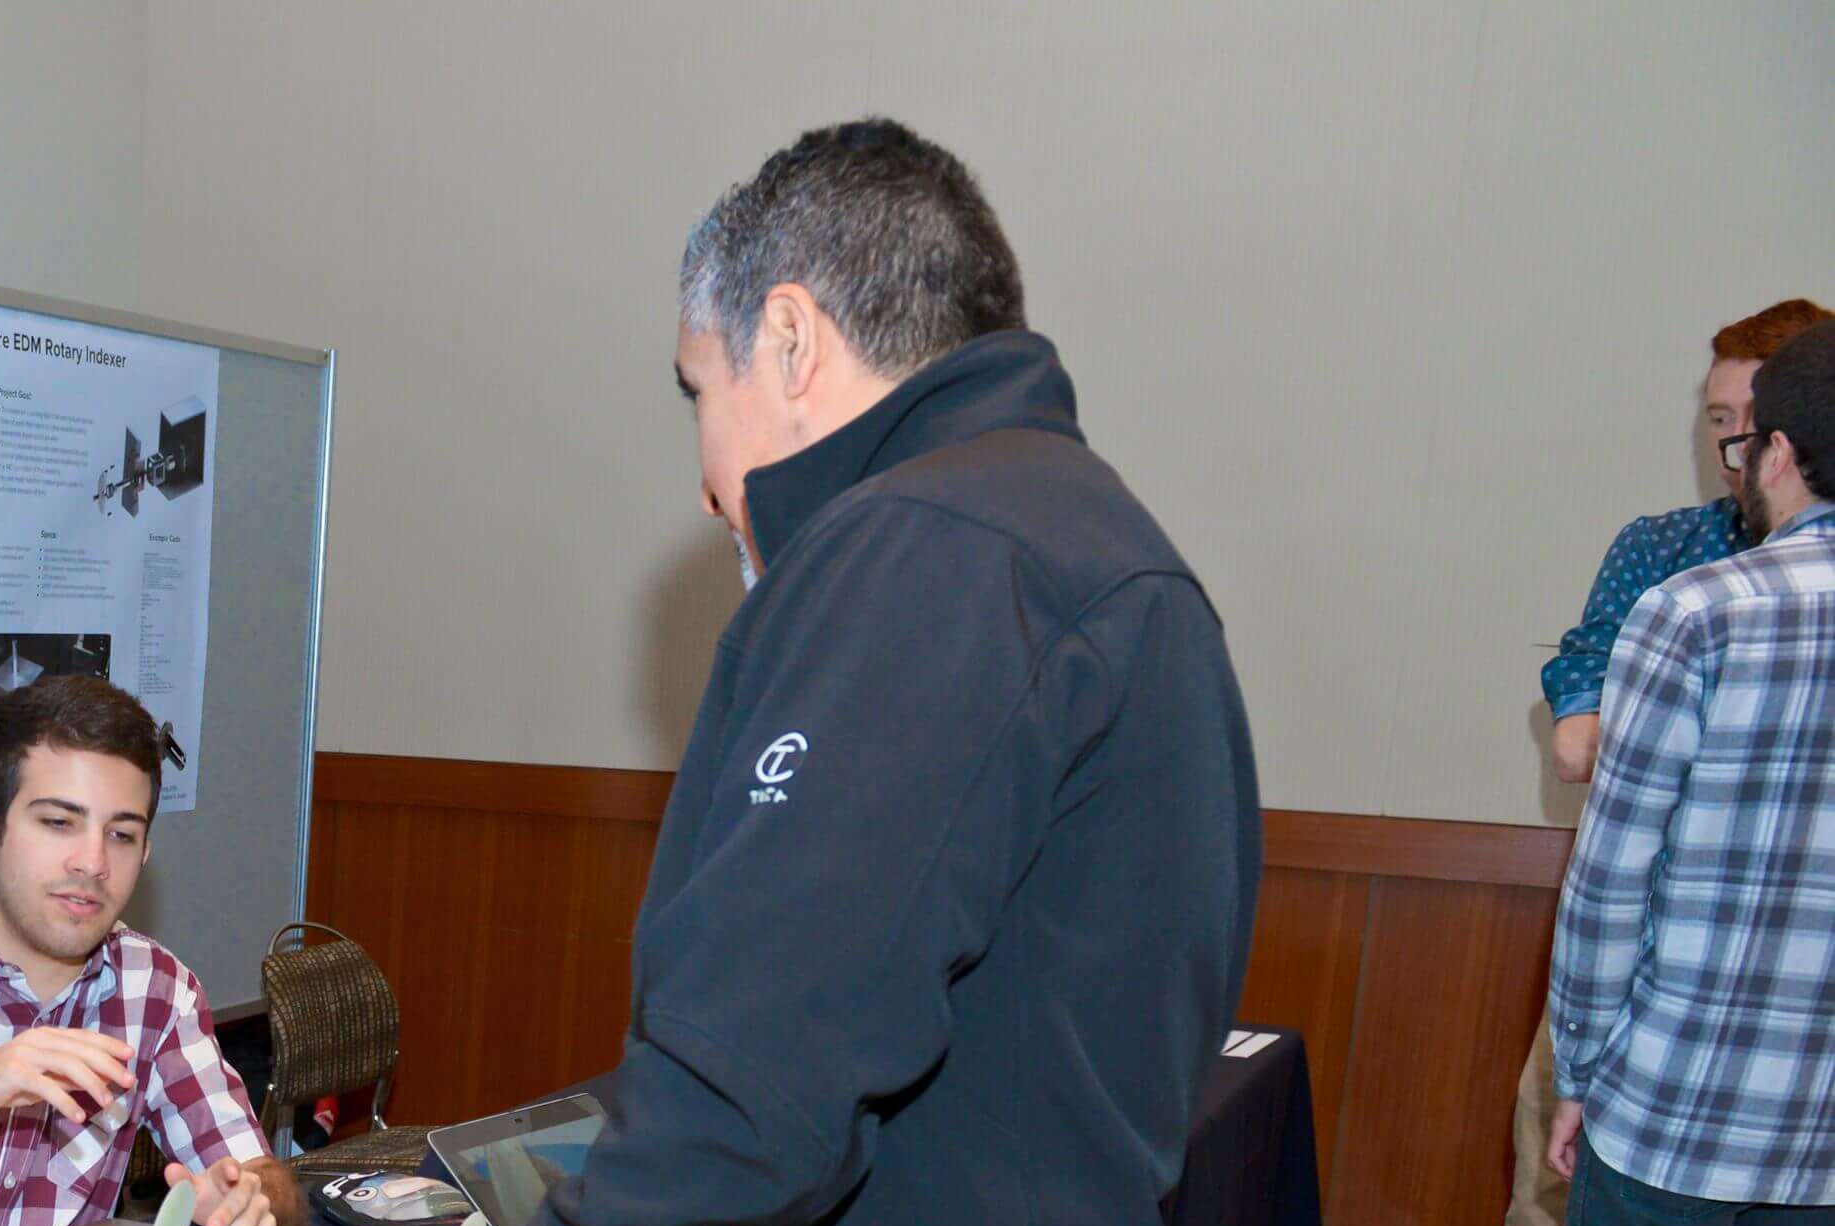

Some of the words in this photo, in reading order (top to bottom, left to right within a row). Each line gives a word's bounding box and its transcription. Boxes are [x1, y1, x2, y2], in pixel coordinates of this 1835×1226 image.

[14, 333, 41, 354] EDM
[46, 339, 82, 364] Rotary
[86, 346, 126, 368] Indexer
